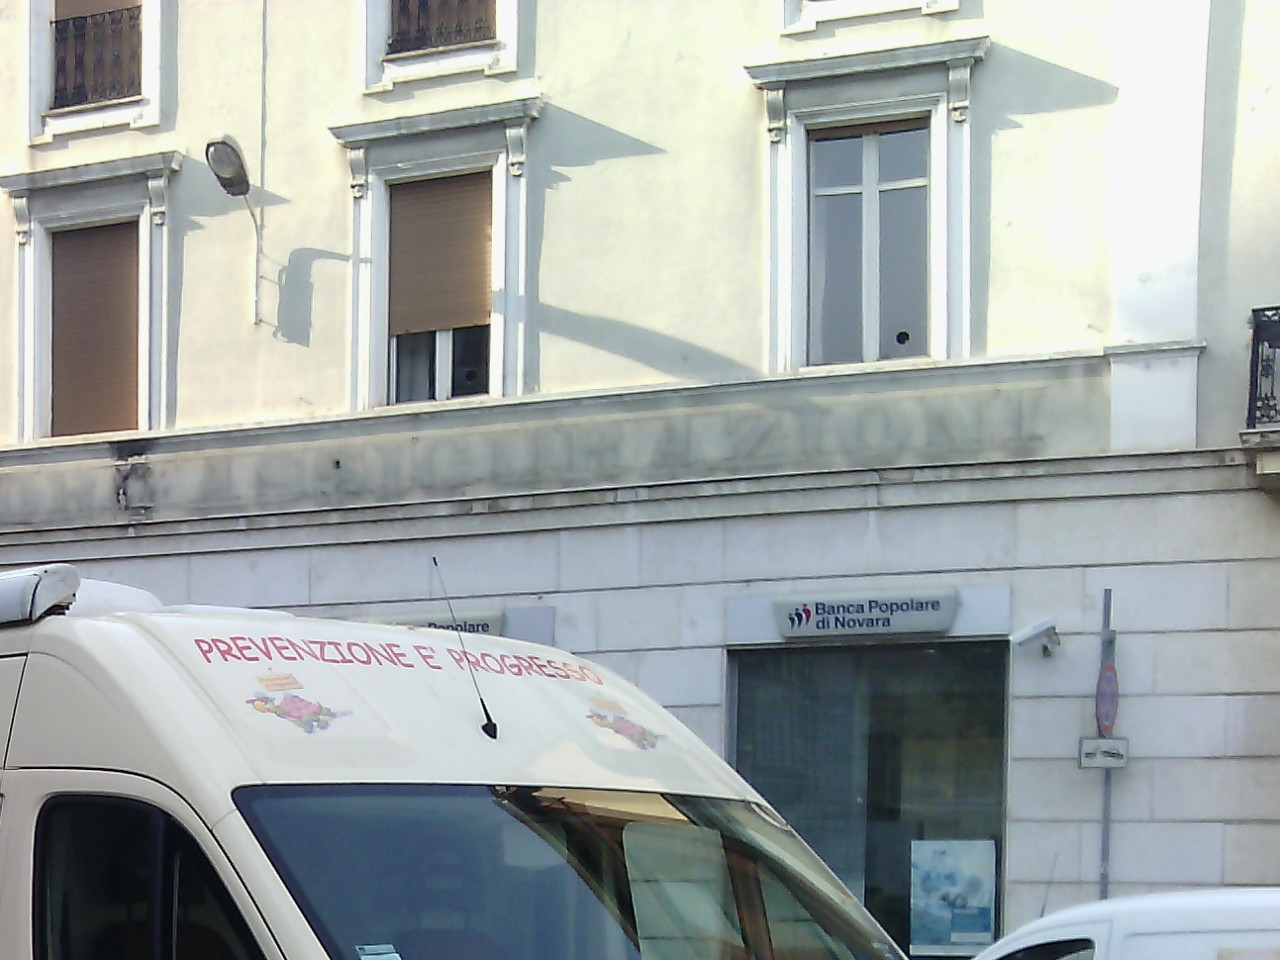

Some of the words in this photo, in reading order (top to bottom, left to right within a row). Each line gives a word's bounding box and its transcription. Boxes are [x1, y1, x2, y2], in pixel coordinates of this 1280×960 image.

[815, 601, 865, 616] Banca
[868, 598, 940, 617] Popolare
[815, 616, 830, 630] di
[834, 616, 891, 629] Novara
[194, 635, 414, 670] PREVENZIONE
[447, 648, 605, 686] PROGRESSO
